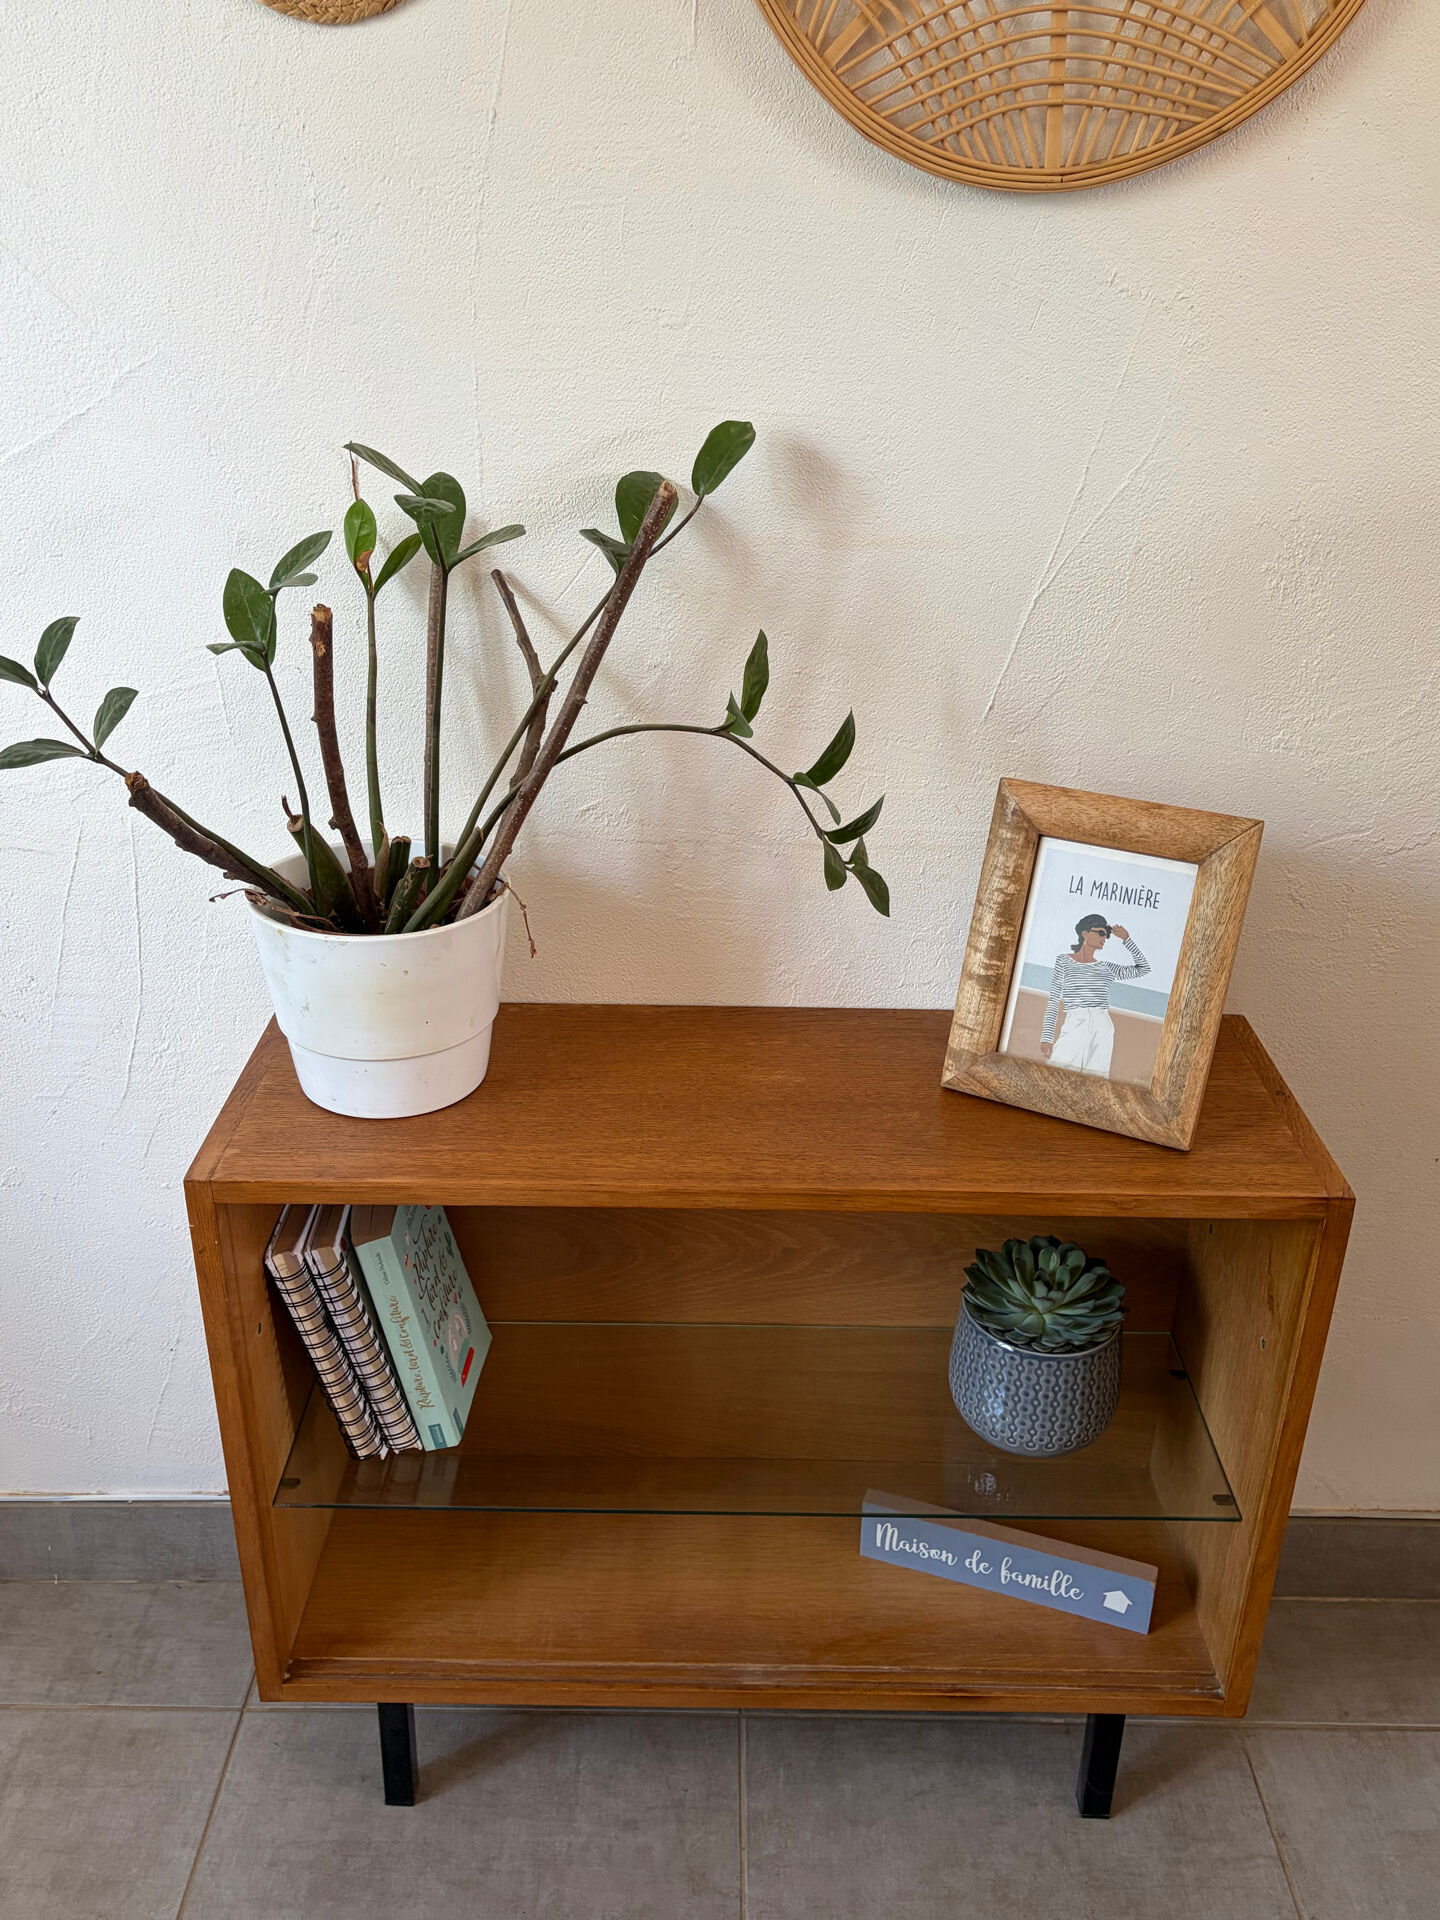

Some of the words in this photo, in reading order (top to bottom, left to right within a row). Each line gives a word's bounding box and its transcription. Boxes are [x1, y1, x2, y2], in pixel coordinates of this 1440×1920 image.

[1069, 875, 1083, 895] LA
[1090, 879, 1161, 910] MARINIÈRE
[876, 1522, 957, 1566] Maison
[965, 1550, 993, 1575] de
[1000, 1557, 1084, 1601] famille
